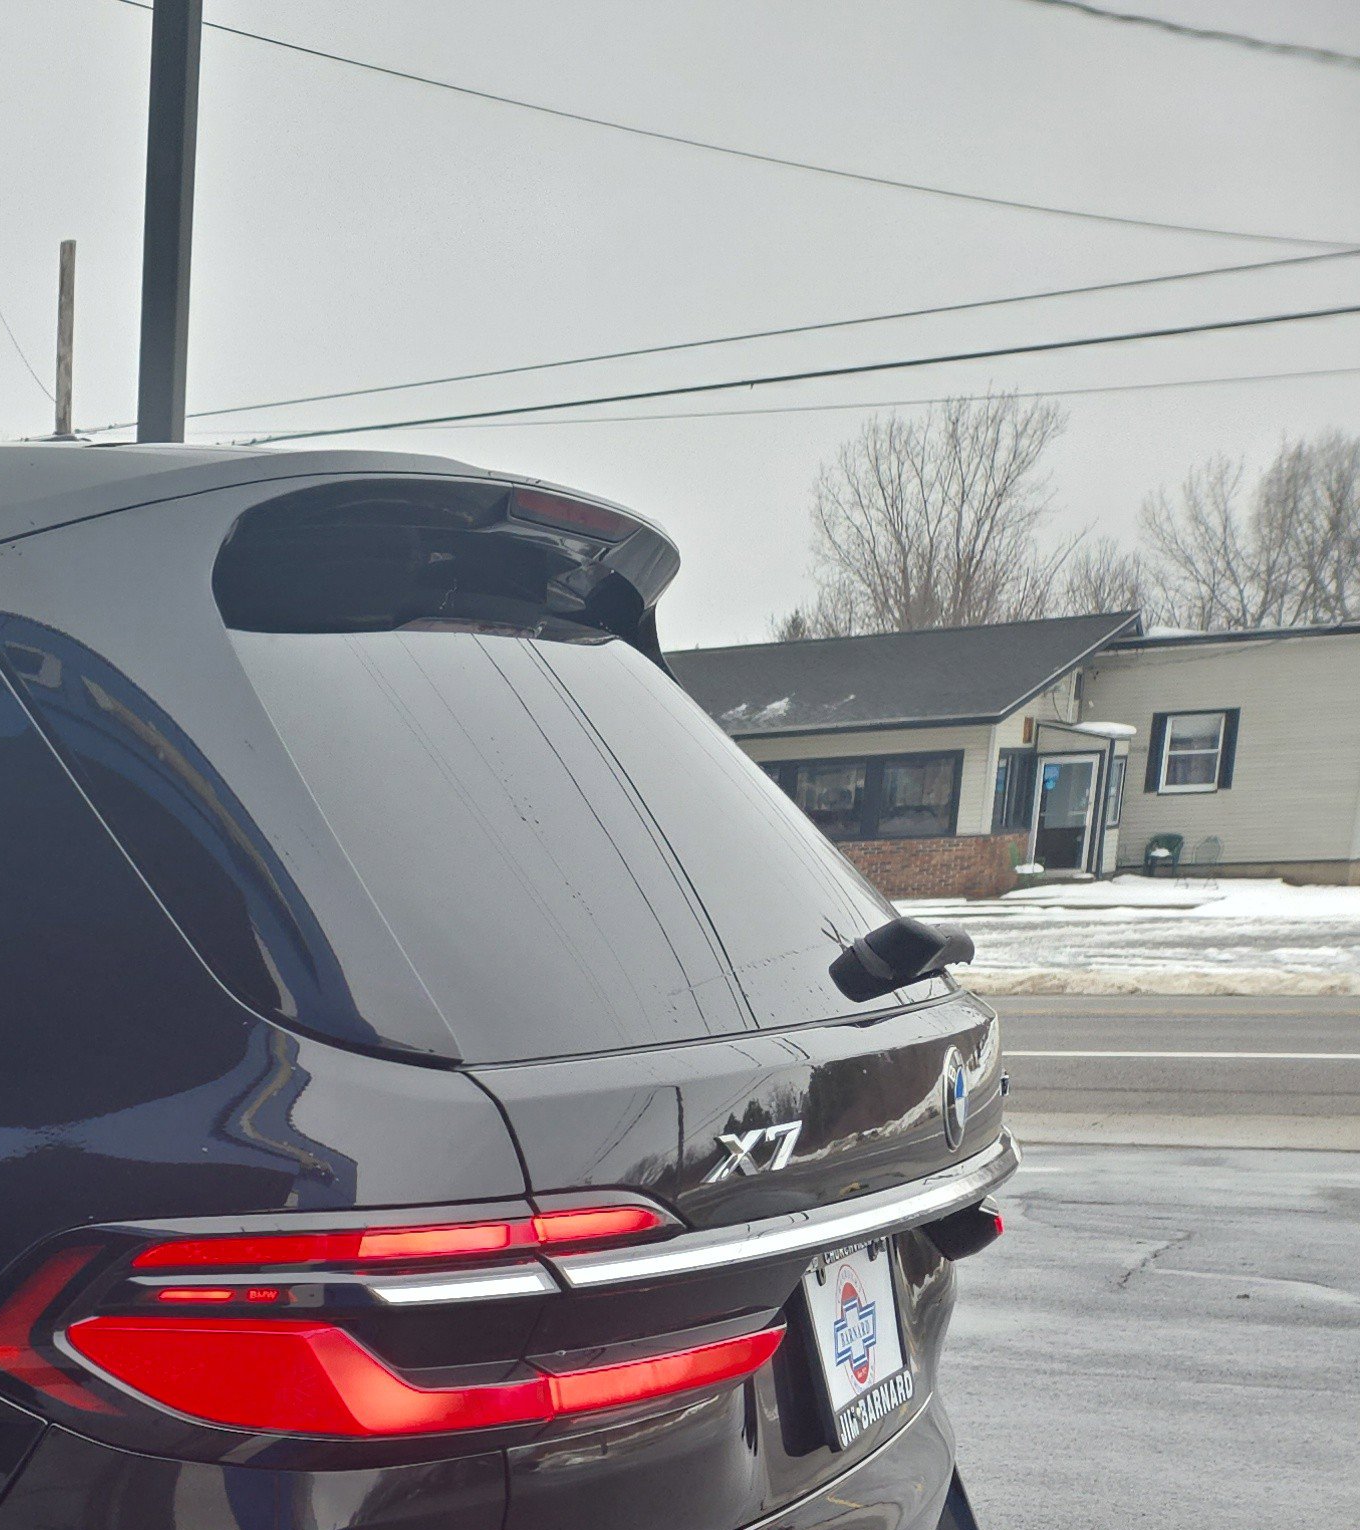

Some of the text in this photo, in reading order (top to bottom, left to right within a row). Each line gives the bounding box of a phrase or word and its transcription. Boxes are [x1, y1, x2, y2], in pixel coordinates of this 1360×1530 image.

[700, 1119, 803, 1184] X7
[249, 1290, 278, 1299] BMW
[840, 1320, 871, 1347] BARNARD
[840, 1408, 860, 1447] JIM
[858, 1371, 913, 1430] BARNARD
